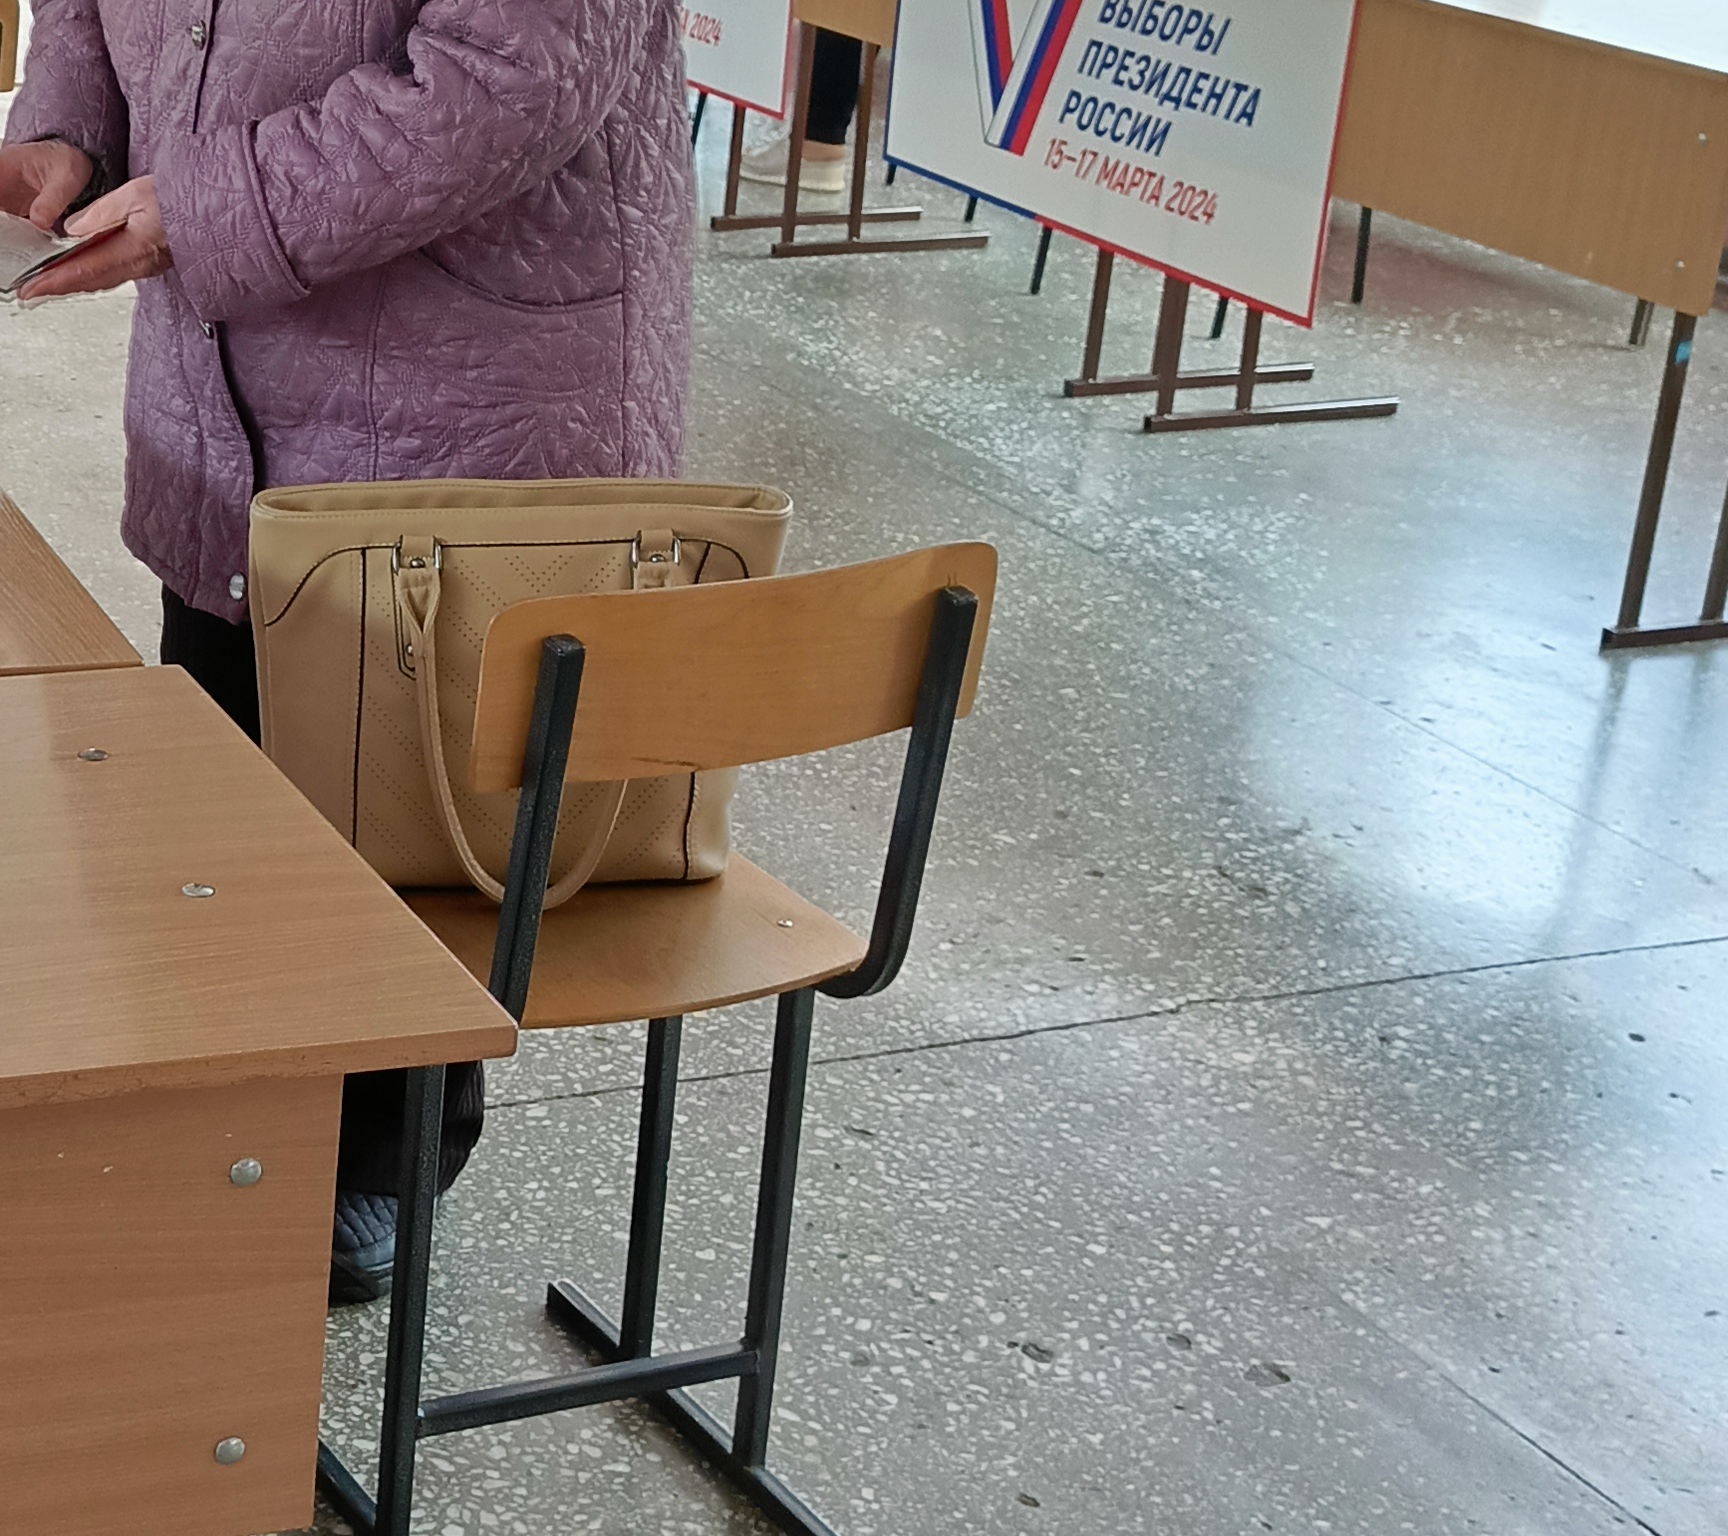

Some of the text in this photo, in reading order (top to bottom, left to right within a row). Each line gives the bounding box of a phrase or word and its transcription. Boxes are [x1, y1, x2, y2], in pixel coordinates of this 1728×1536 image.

[688, 13, 724, 47] 2024
[1077, 38, 1262, 128] ПРЕЗИДЕНТА
[1058, 89, 1173, 157] РОССИИ
[1095, 155, 1166, 208] МАРТА
[1164, 181, 1220, 225] 2024
